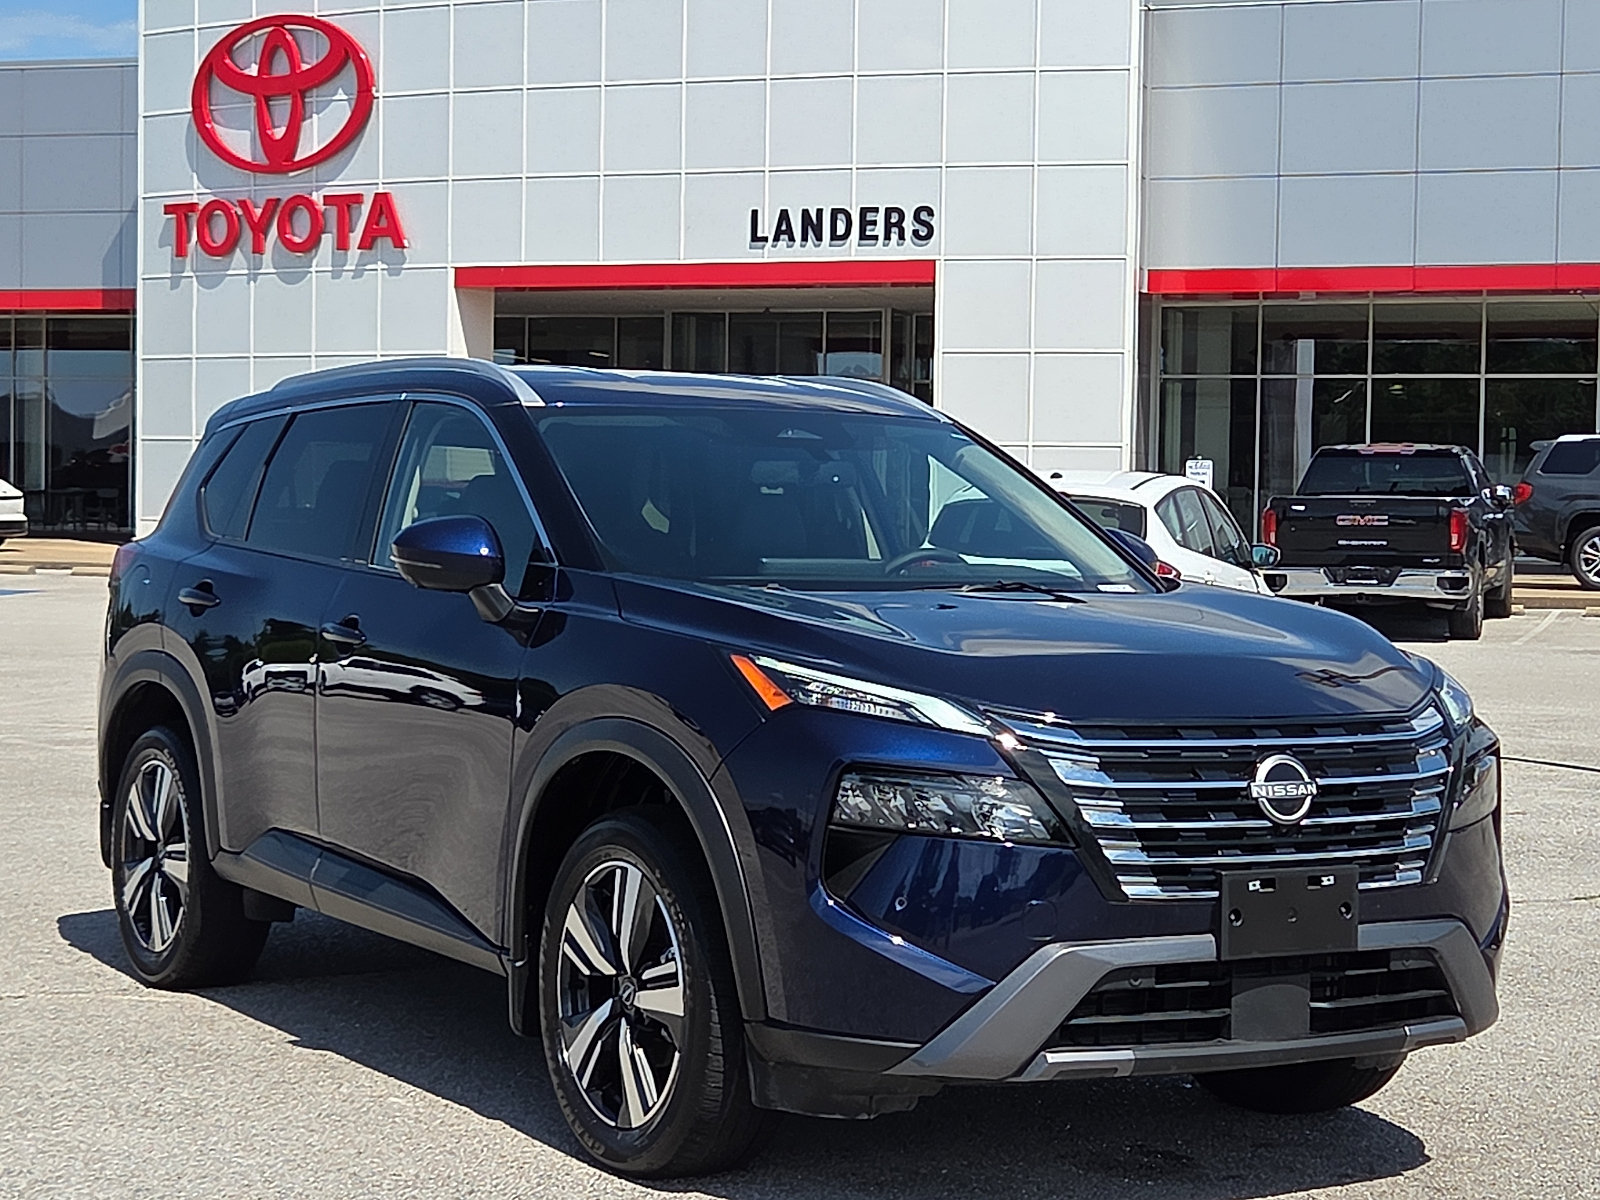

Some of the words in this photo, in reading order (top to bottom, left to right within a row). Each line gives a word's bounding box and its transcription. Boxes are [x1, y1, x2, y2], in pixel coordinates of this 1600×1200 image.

[163, 192, 408, 258] TOYOTA
[749, 205, 935, 247] LANDERS
[1336, 515, 1389, 526] GMC
[1251, 783, 1317, 798] NISSAN
